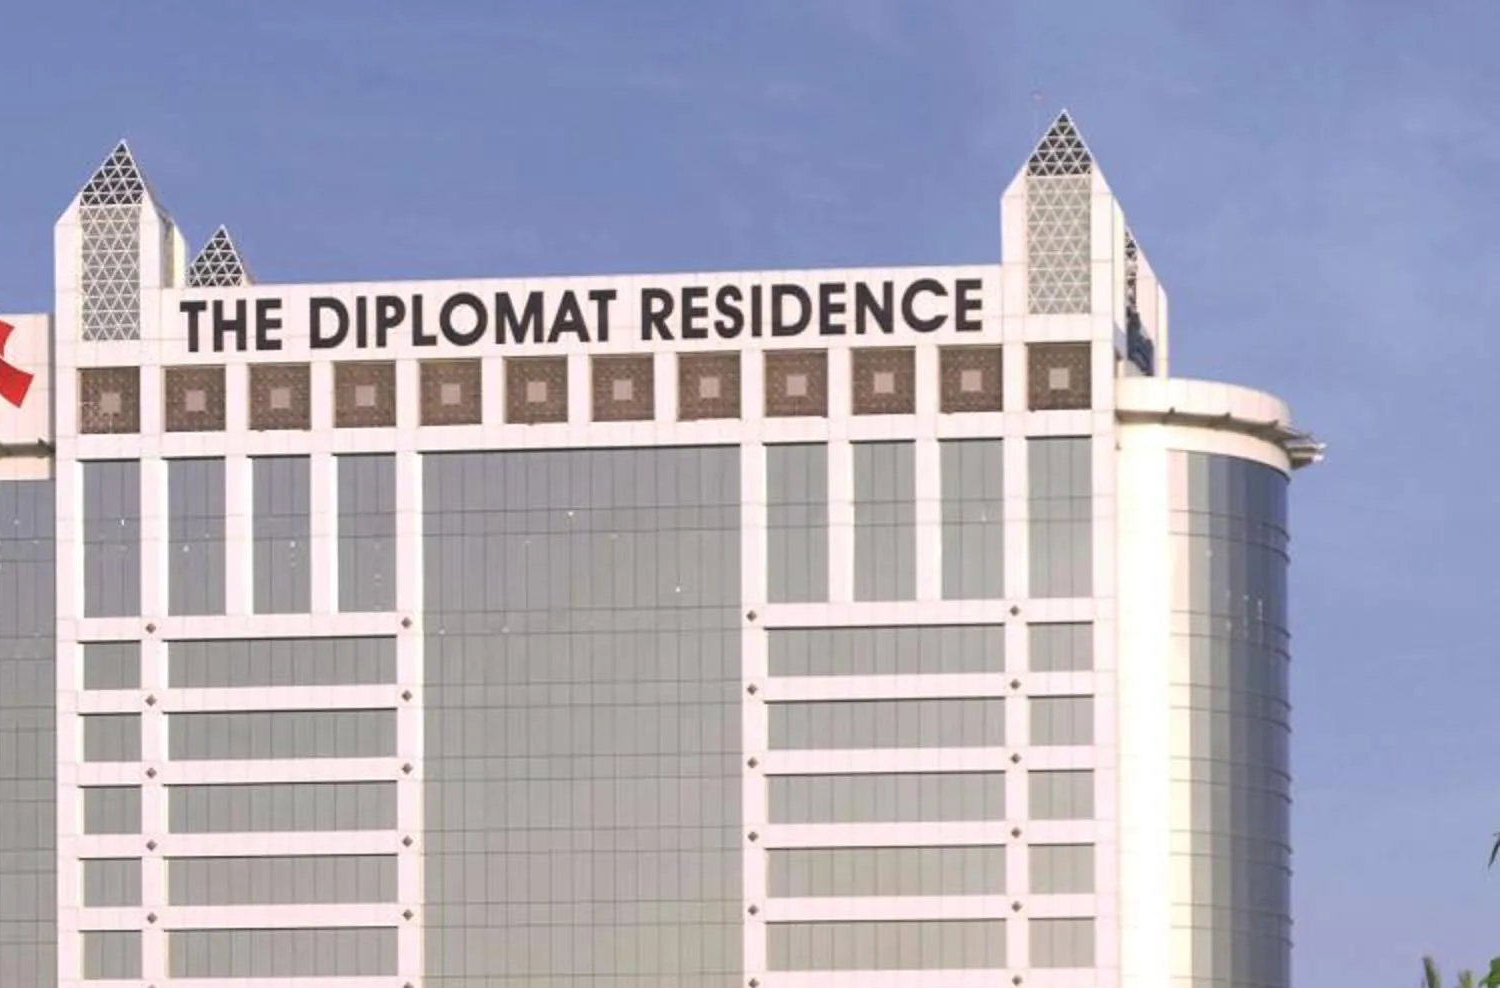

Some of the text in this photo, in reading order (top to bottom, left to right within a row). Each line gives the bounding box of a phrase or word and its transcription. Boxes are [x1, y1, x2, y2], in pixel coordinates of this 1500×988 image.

[179, 278, 984, 353] THE DIPLOMAT RESIDENCE
